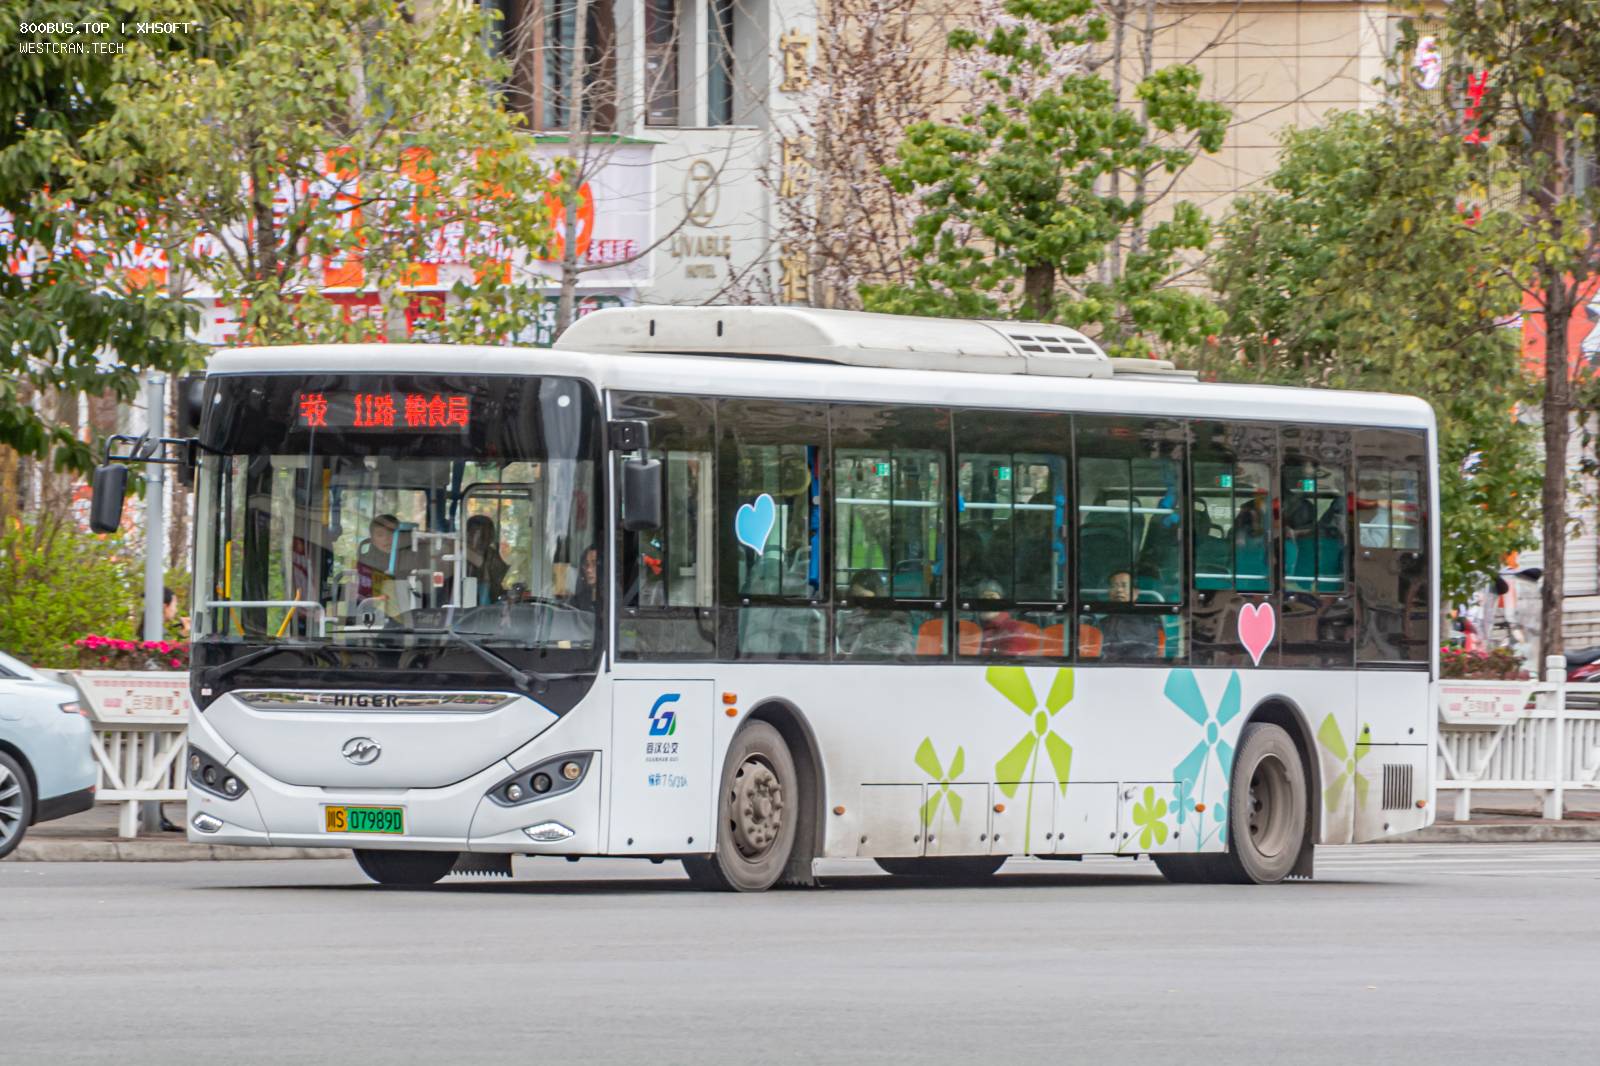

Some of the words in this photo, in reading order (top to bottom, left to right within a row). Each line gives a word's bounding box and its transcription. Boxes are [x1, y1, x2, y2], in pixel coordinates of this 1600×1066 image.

[671, 235, 731, 258] LIVABLE
[353, 393, 397, 427] 11路
[404, 393, 470, 427] 粮食局
[334, 694, 399, 708] HIGER
